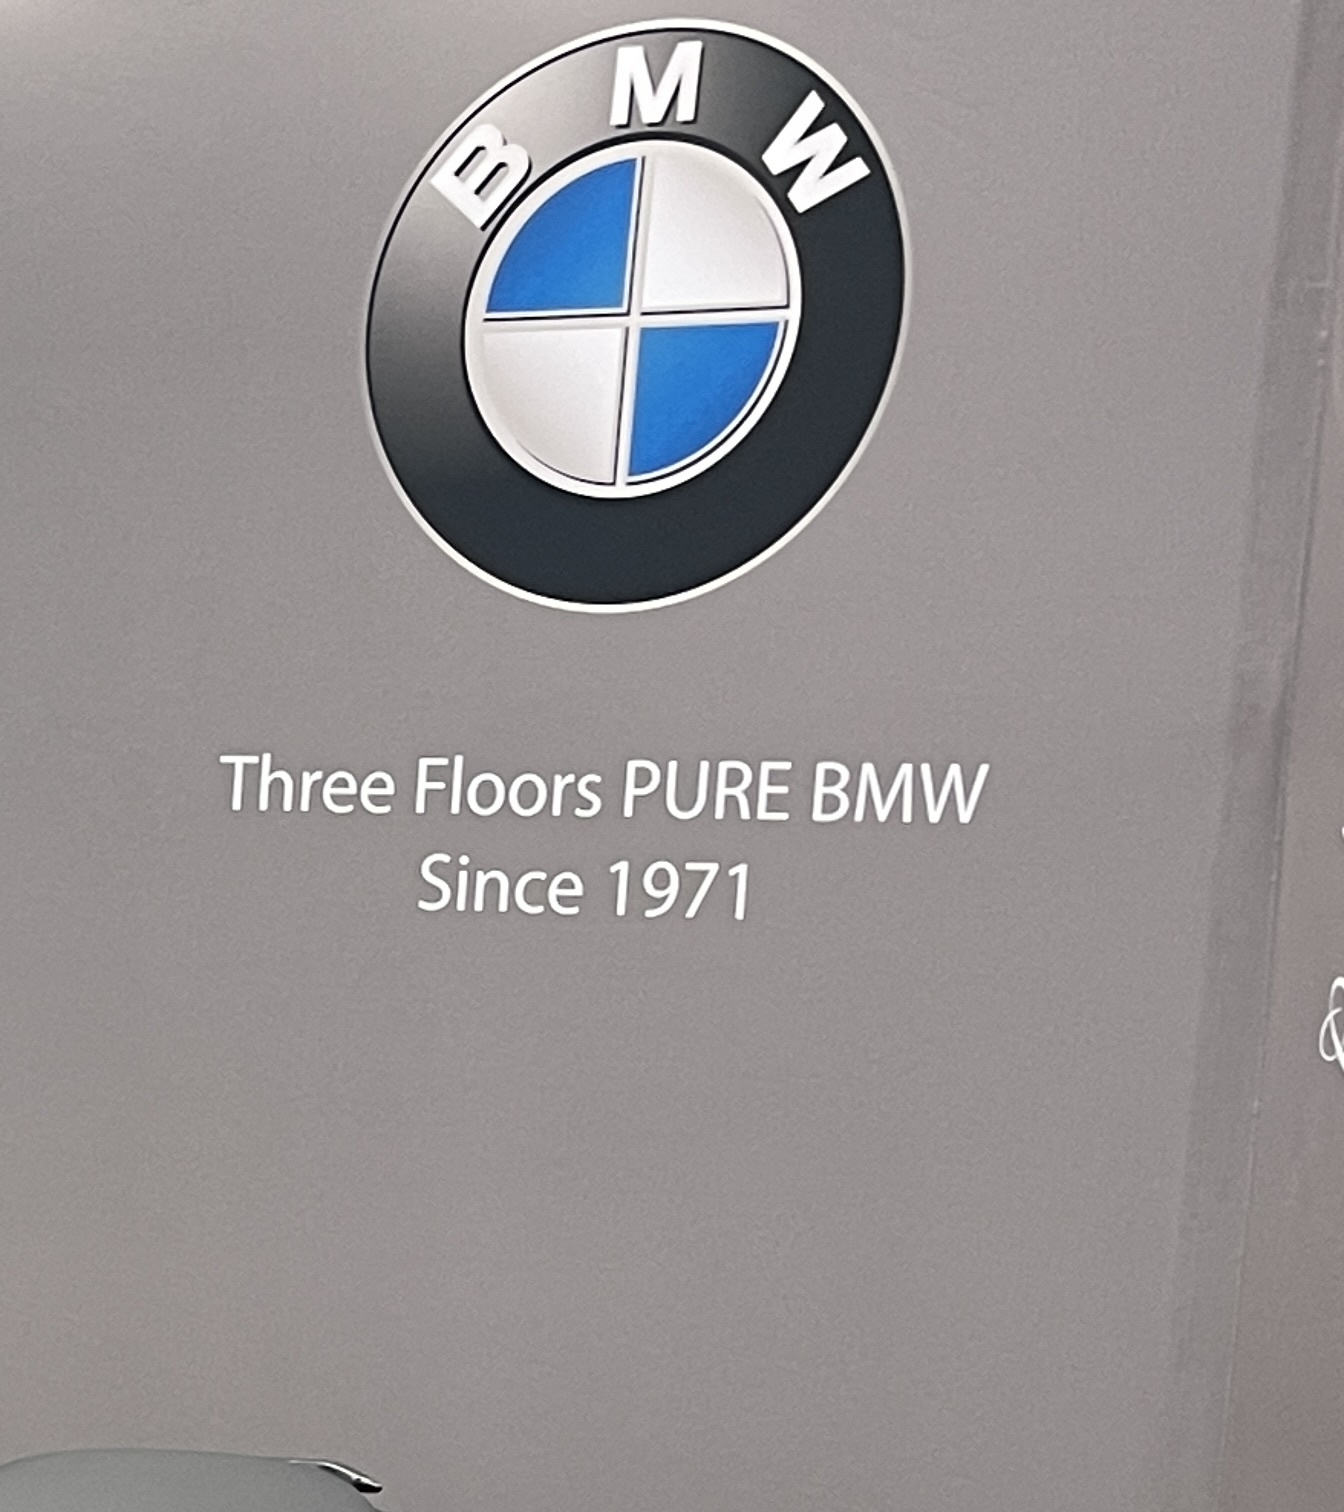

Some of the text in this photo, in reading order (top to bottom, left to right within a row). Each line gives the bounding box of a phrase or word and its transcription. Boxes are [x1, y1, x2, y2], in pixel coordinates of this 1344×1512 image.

[429, 40, 872, 231] BMW
[219, 752, 991, 824] Three Floors PURE BMW
[418, 853, 750, 921] Since 1971
